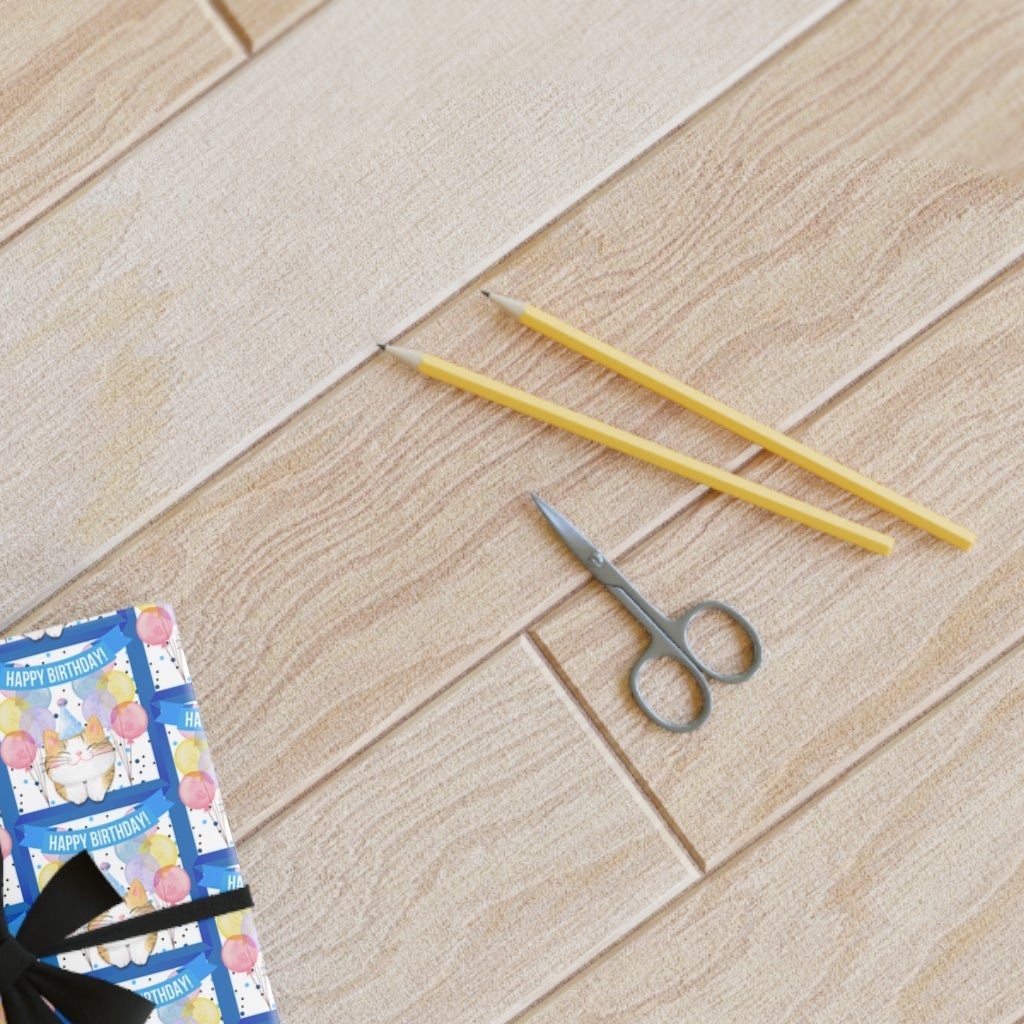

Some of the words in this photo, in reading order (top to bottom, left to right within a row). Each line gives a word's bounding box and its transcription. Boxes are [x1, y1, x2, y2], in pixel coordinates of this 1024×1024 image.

[5, 667, 45, 687] HAPPY
[47, 647, 106, 684] BIRTHDAY!
[49, 830, 88, 851] HAPPY
[90, 810, 150, 847] BIRTHDAY!
[143, 974, 194, 1005] RTHDAY!
